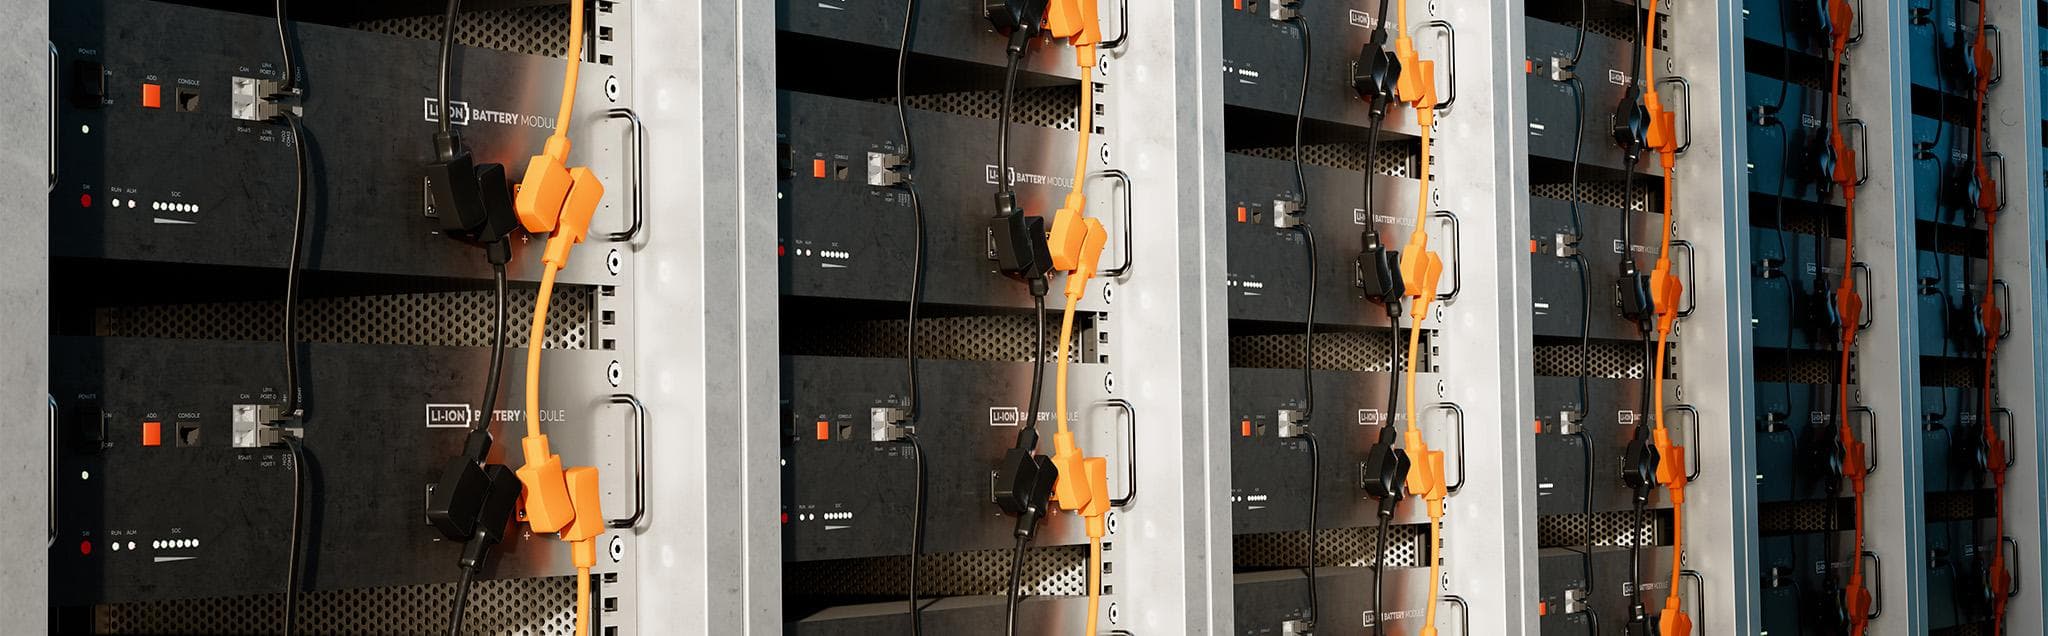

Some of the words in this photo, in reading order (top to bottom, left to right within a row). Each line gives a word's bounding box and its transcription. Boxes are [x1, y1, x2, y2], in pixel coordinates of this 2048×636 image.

[177, 78, 200, 86] CONSOLE
[429, 103, 464, 119] LION
[472, 108, 519, 125] BATTERY
[520, 113, 558, 130] MODUL
[1016, 172, 1046, 185] BATTERY
[431, 409, 466, 422] LI-ION
[474, 409, 520, 422] BTERY
[993, 412, 1015, 421] LI-ION
[1020, 412, 1050, 422] BAERY
